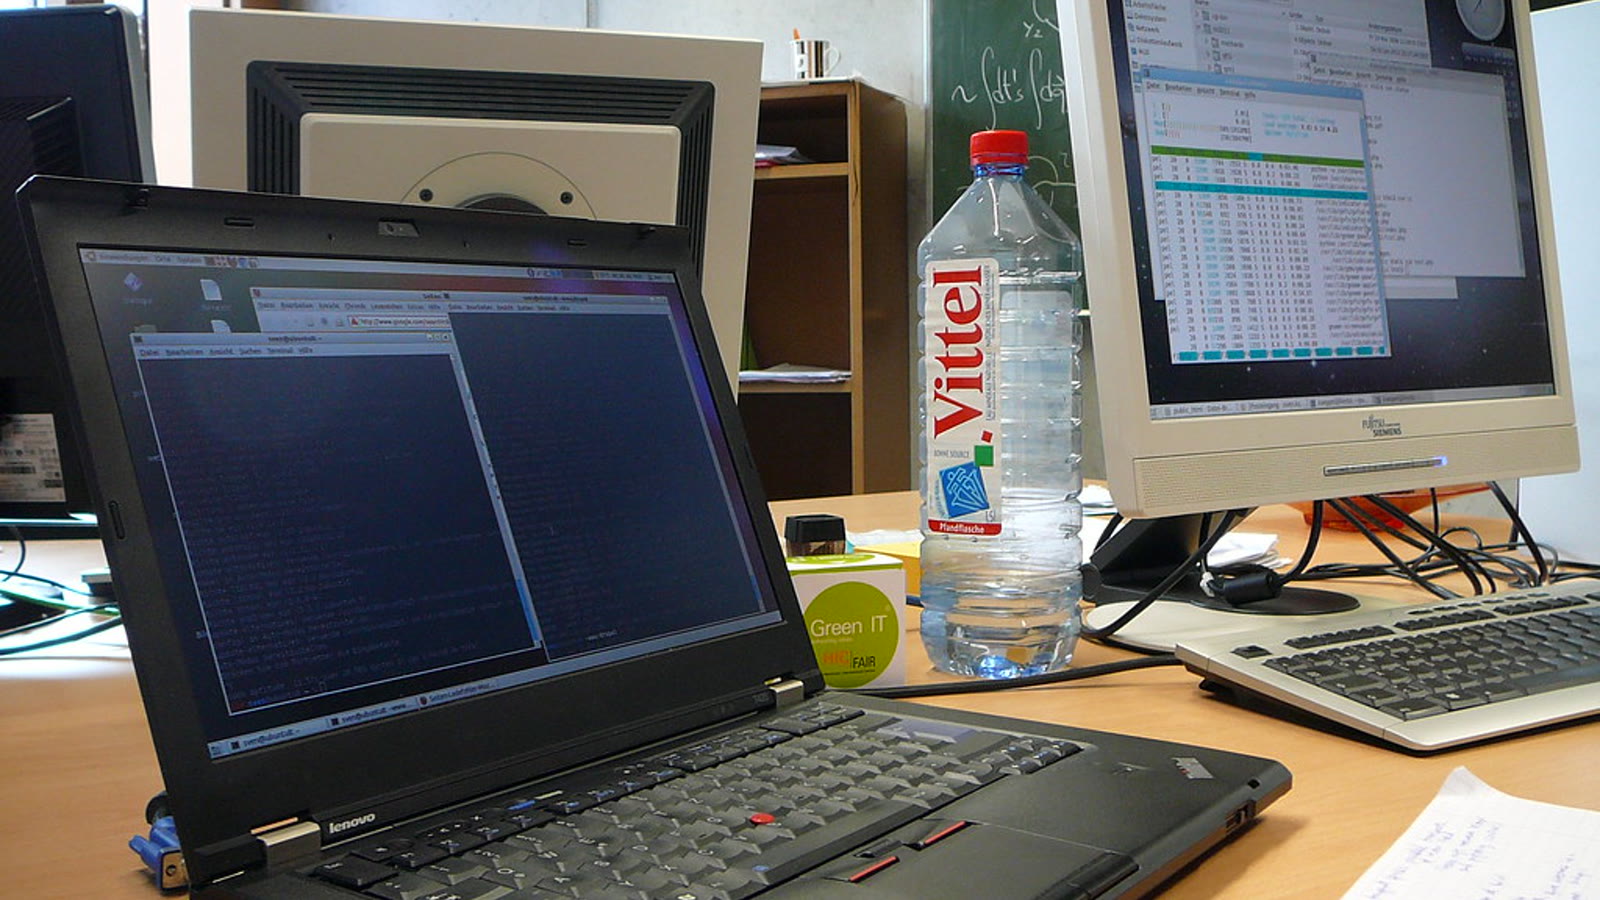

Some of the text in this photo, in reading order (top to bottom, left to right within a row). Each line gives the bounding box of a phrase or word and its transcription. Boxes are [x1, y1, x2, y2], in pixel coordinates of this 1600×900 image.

[932, 264, 984, 440] Vittel
[810, 614, 888, 638] Green IT
[852, 655, 876, 669] FAIR
[328, 813, 376, 834] lenovo
